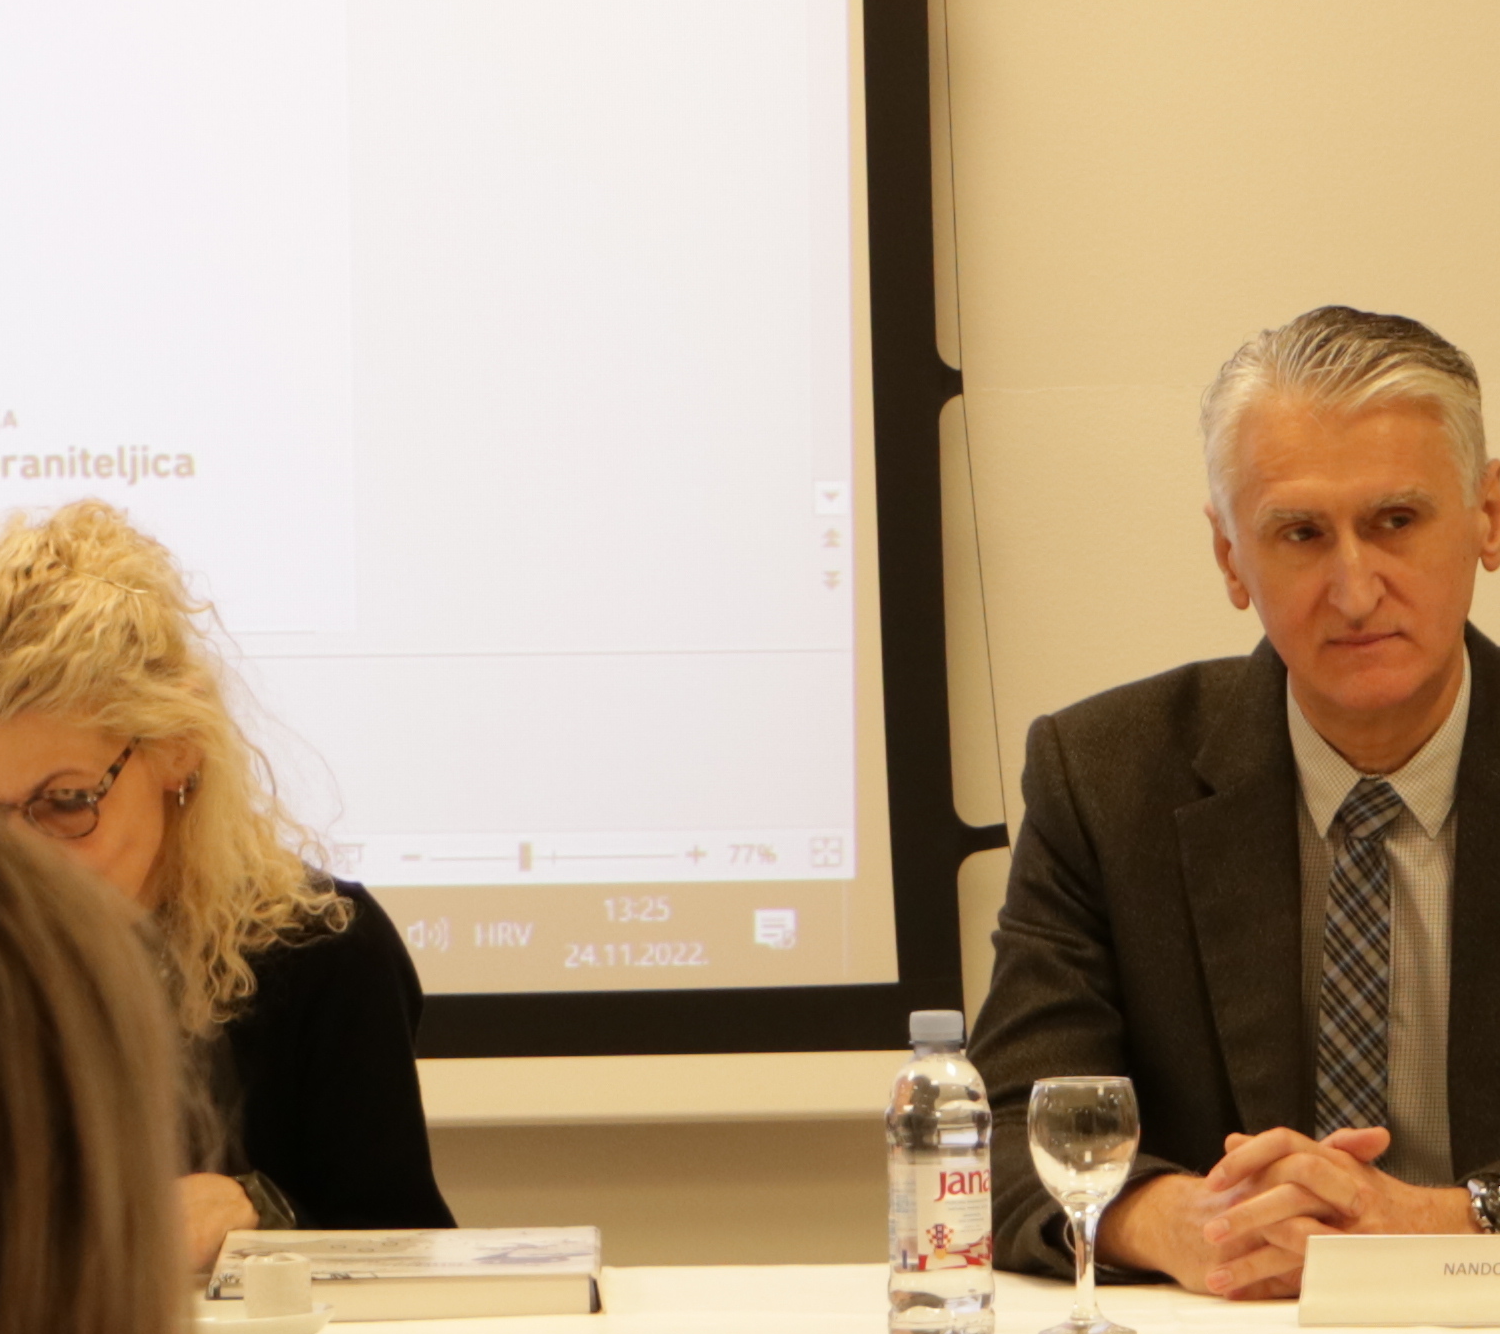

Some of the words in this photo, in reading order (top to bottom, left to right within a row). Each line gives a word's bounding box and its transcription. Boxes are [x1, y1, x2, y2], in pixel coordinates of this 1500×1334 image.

[731, 844, 777, 863] 77%
[605, 898, 670, 922] 13:25
[476, 923, 531, 945] HRV
